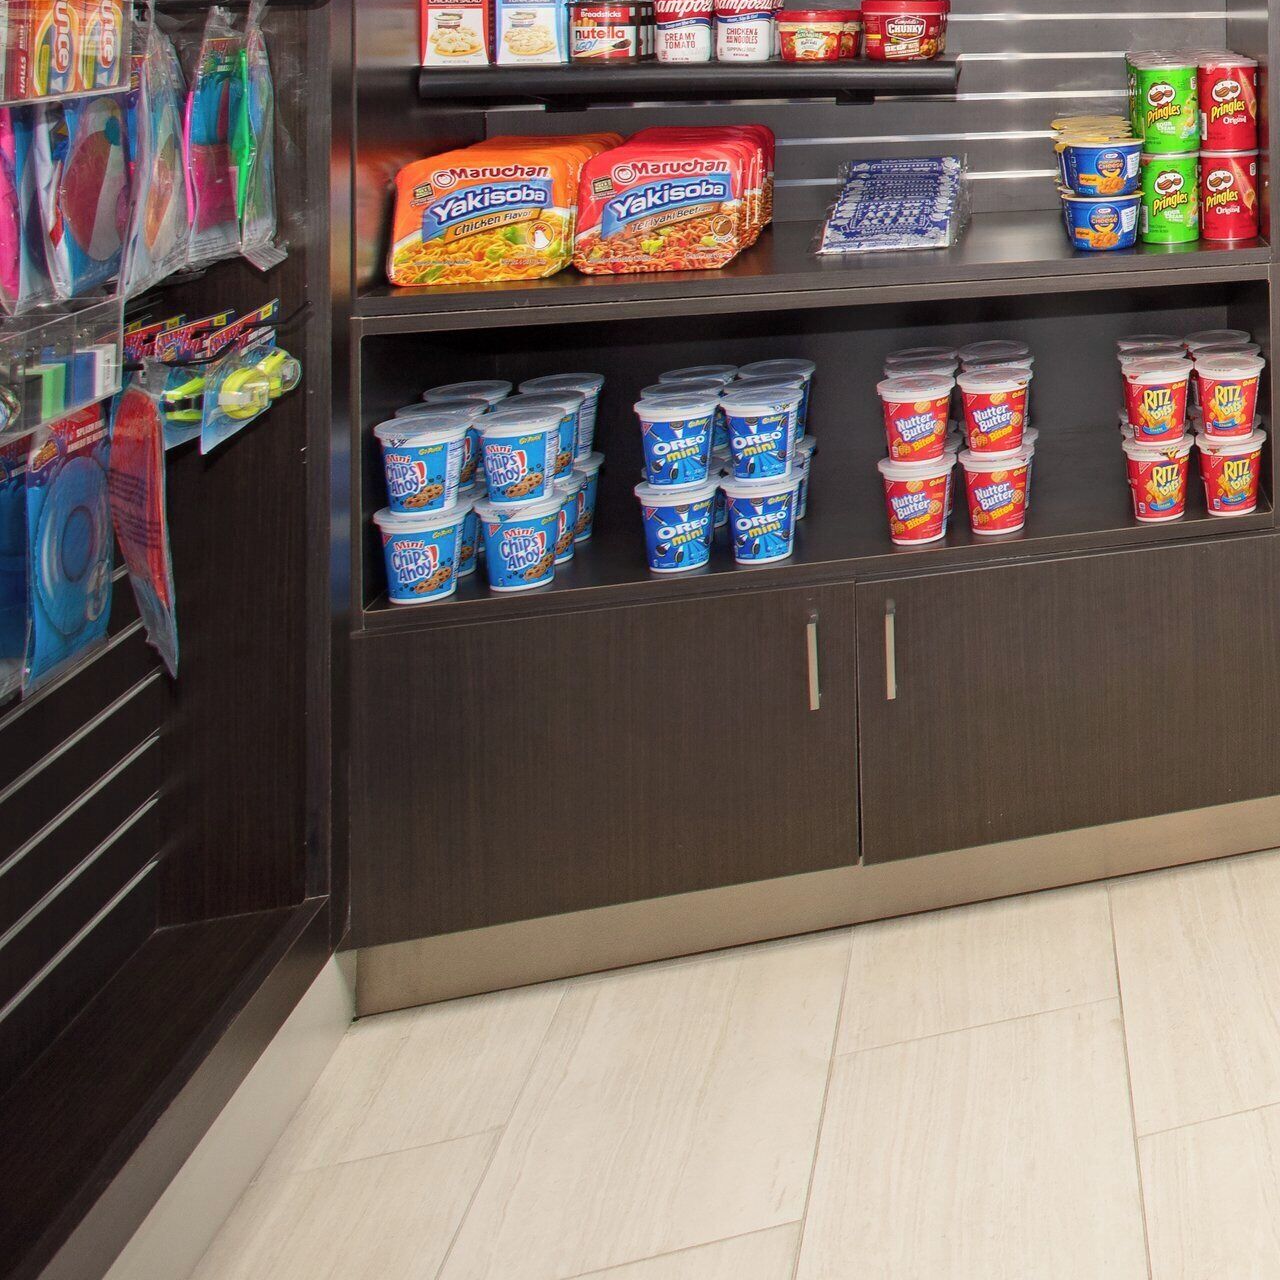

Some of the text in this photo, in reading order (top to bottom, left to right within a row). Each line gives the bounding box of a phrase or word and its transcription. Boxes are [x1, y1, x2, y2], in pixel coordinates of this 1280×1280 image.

[580, 10, 621, 18] Breadsticks
[575, 27, 625, 39] nutella
[664, 33, 696, 42] CREAMY
[733, 35, 758, 44] NOODLES
[664, 41, 696, 49] TOMATO
[1147, 103, 1181, 127] Pringles
[1211, 98, 1245, 119] Pringles
[1223, 115, 1247, 124] Original
[448, 165, 550, 181] Maruchan
[432, 185, 547, 222] Yakisoba
[613, 182, 725, 220] Yakisoba
[453, 209, 534, 237] Chicken Flavor
[631, 208, 699, 231] Teriyaki Beef
[1144, 388, 1171, 410] RITZ
[1214, 384, 1243, 407] RITZ
[972, 404, 1008, 422] Nutter
[978, 410, 1012, 432] Butter
[732, 430, 782, 450] OREO
[990, 425, 1013, 444] Bites
[742, 440, 776, 457] mini
[502, 526, 535, 539] Mini
[499, 536, 539, 556] Chips
[506, 549, 540, 571] Ahoy
